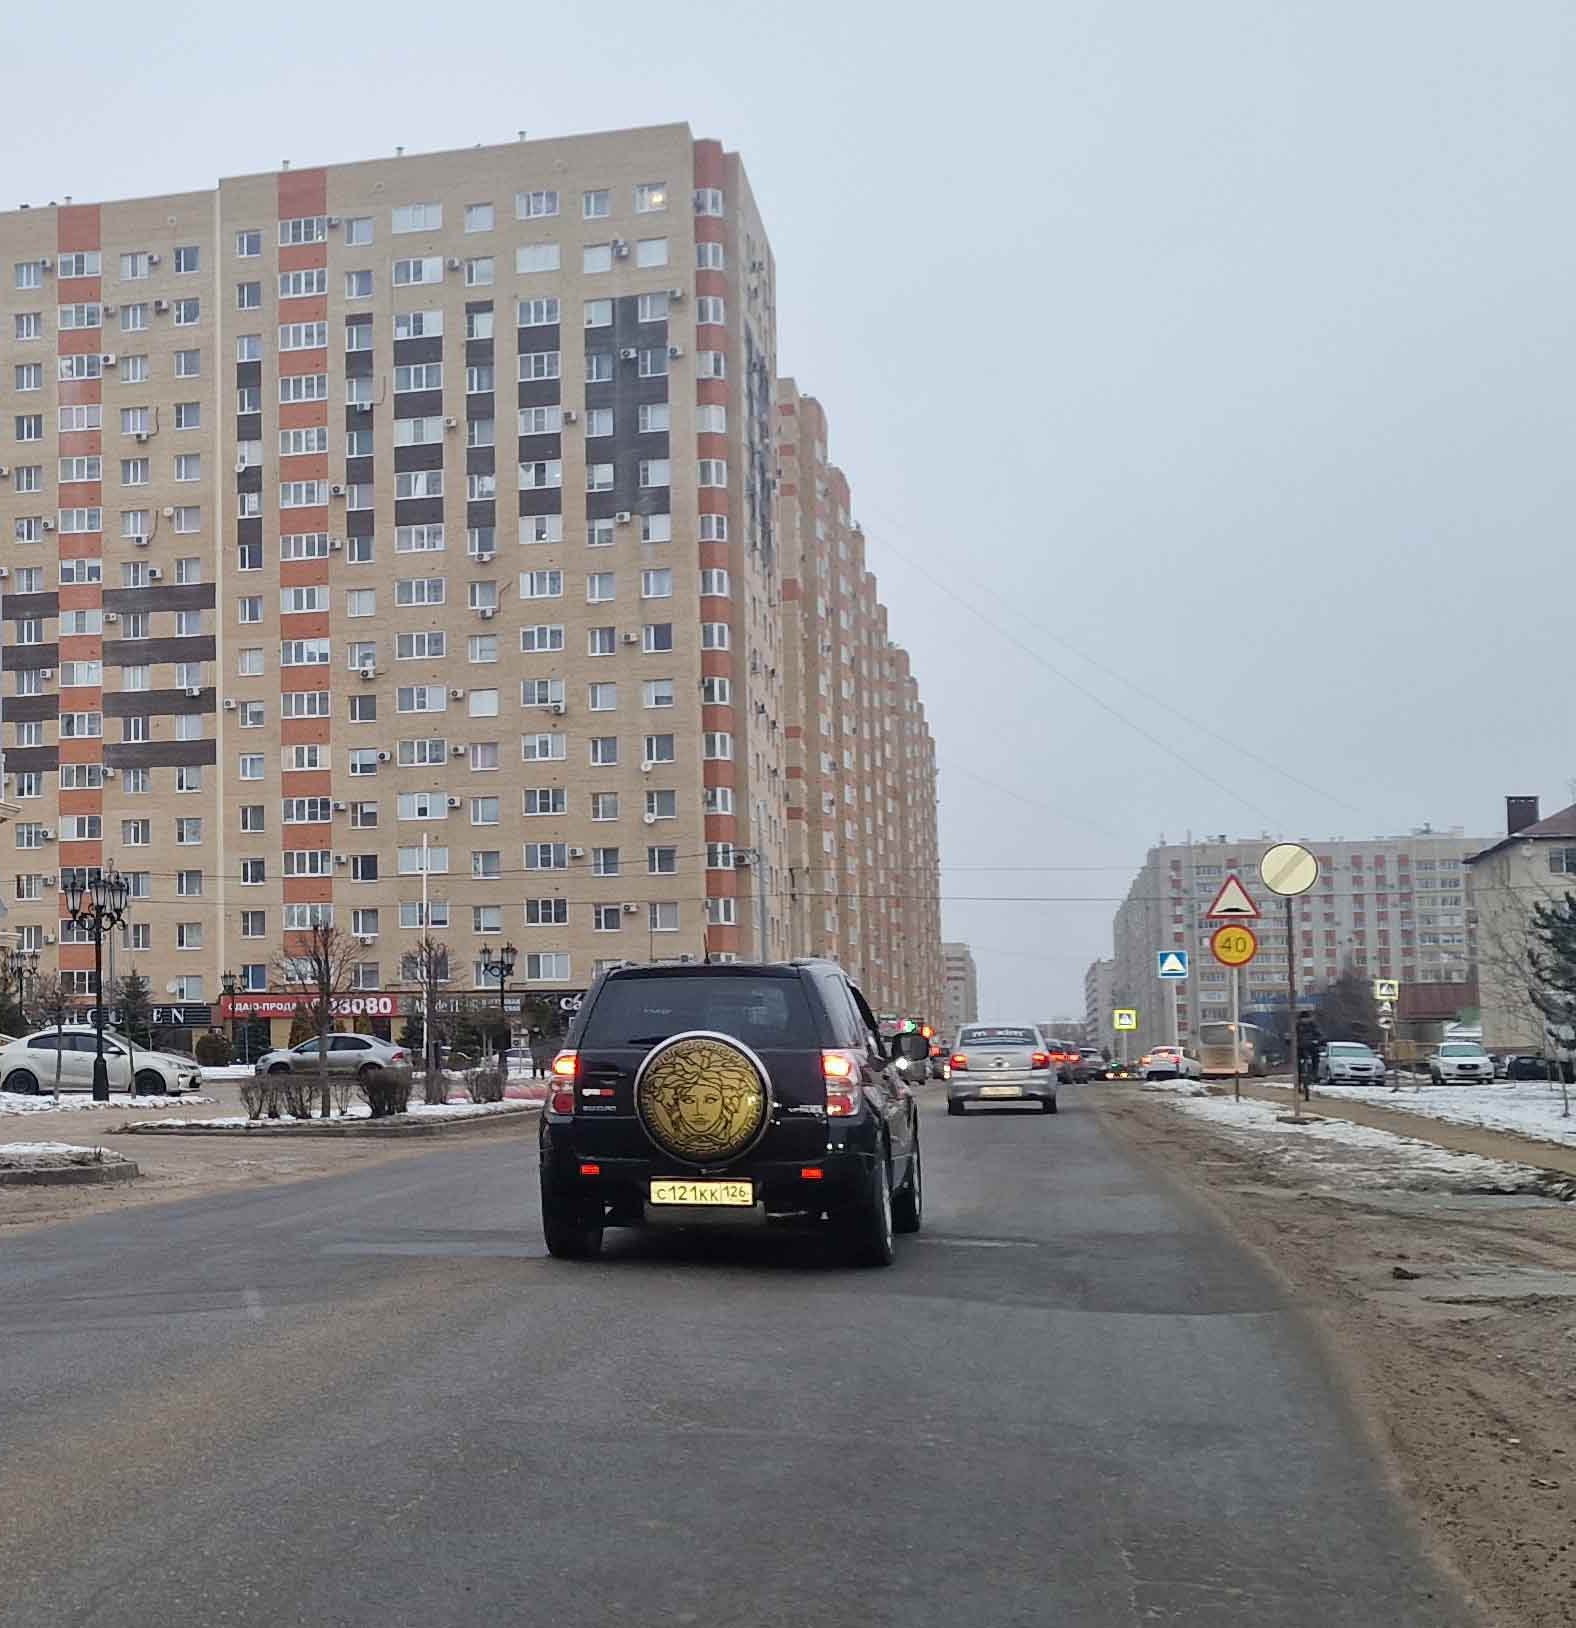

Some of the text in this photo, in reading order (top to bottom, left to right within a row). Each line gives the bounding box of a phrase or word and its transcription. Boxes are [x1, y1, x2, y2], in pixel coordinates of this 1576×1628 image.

[1219, 936, 1247, 953] 40
[228, 1002, 308, 1012] СДАЮ-ПРОДА
[723, 1184, 747, 1198] 126
